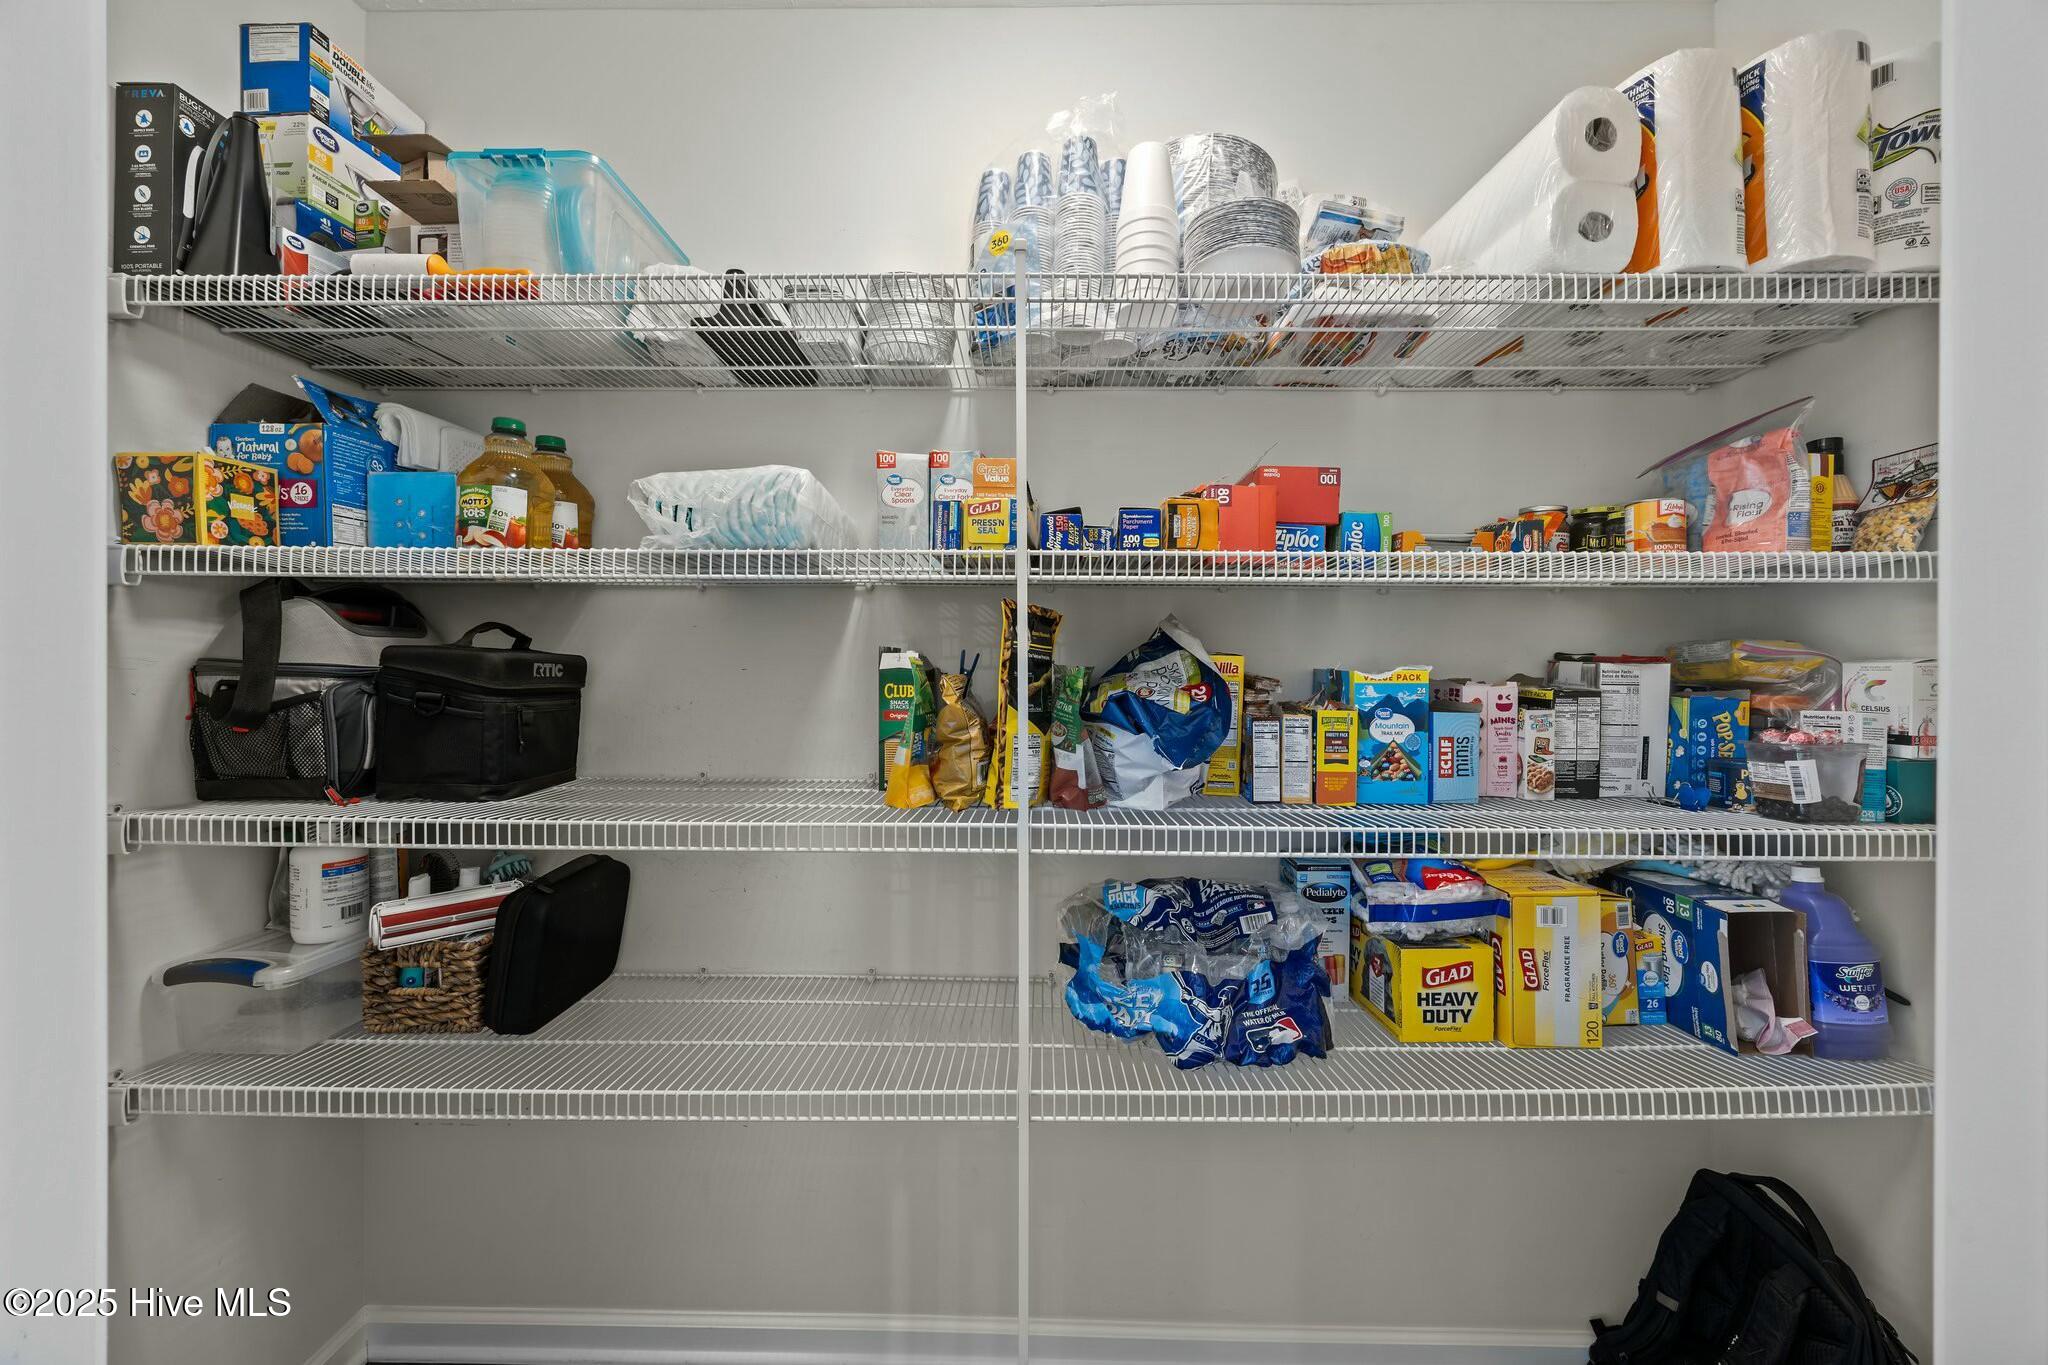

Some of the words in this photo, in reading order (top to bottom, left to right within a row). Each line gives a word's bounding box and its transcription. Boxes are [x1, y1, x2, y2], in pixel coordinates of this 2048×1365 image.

[331, 59, 359, 86] HALOGEN
[332, 51, 365, 84] DOUBLE
[1894, 185, 1911, 195] USA
[236, 442, 280, 453] Natural
[236, 451, 250, 460] for
[251, 453, 273, 462] Baby
[879, 454, 895, 463] 100
[933, 453, 949, 462] 100
[977, 464, 1009, 476] Great
[984, 474, 1010, 483] Value
[1319, 474, 1338, 484] 100
[294, 485, 308, 495] 16
[1217, 487, 1230, 504] 80
[463, 508, 486, 518] tots
[970, 502, 1000, 515] GLAD
[1733, 502, 1763, 512] Rising
[1736, 509, 1763, 518] Flour
[1055, 515, 1064, 531] 150
[977, 526, 998, 534] SEAL
[1067, 521, 1075, 546] HEAVY
[1122, 534, 1140, 543] 100
[534, 663, 564, 678] RTIC
[1396, 673, 1422, 681] PACK
[884, 683, 914, 699] CLUB
[1860, 704, 1891, 713] CELSIUS
[1440, 739, 1452, 767] CLIF
[1456, 736, 1470, 777] minis
[1108, 891, 1139, 904] PACK
[1306, 888, 1347, 898] Pedialyte
[1665, 898, 1675, 915] 80
[1680, 902, 1690, 917] 13
[1636, 942, 1653, 950] GLAD
[1677, 935, 1686, 959] Great
[1425, 965, 1472, 985] GLAD
[1523, 950, 1539, 988] GLAD
[1542, 950, 1551, 992] ForceFlex
[1836, 965, 1875, 981] Swiffer
[1416, 991, 1479, 1007] HEAVY
[1646, 999, 1659, 1009] 26
[1242, 1016, 1262, 1027] WATER
[1422, 1009, 1473, 1024] DUTY
[1586, 1020, 1599, 1044] 120
